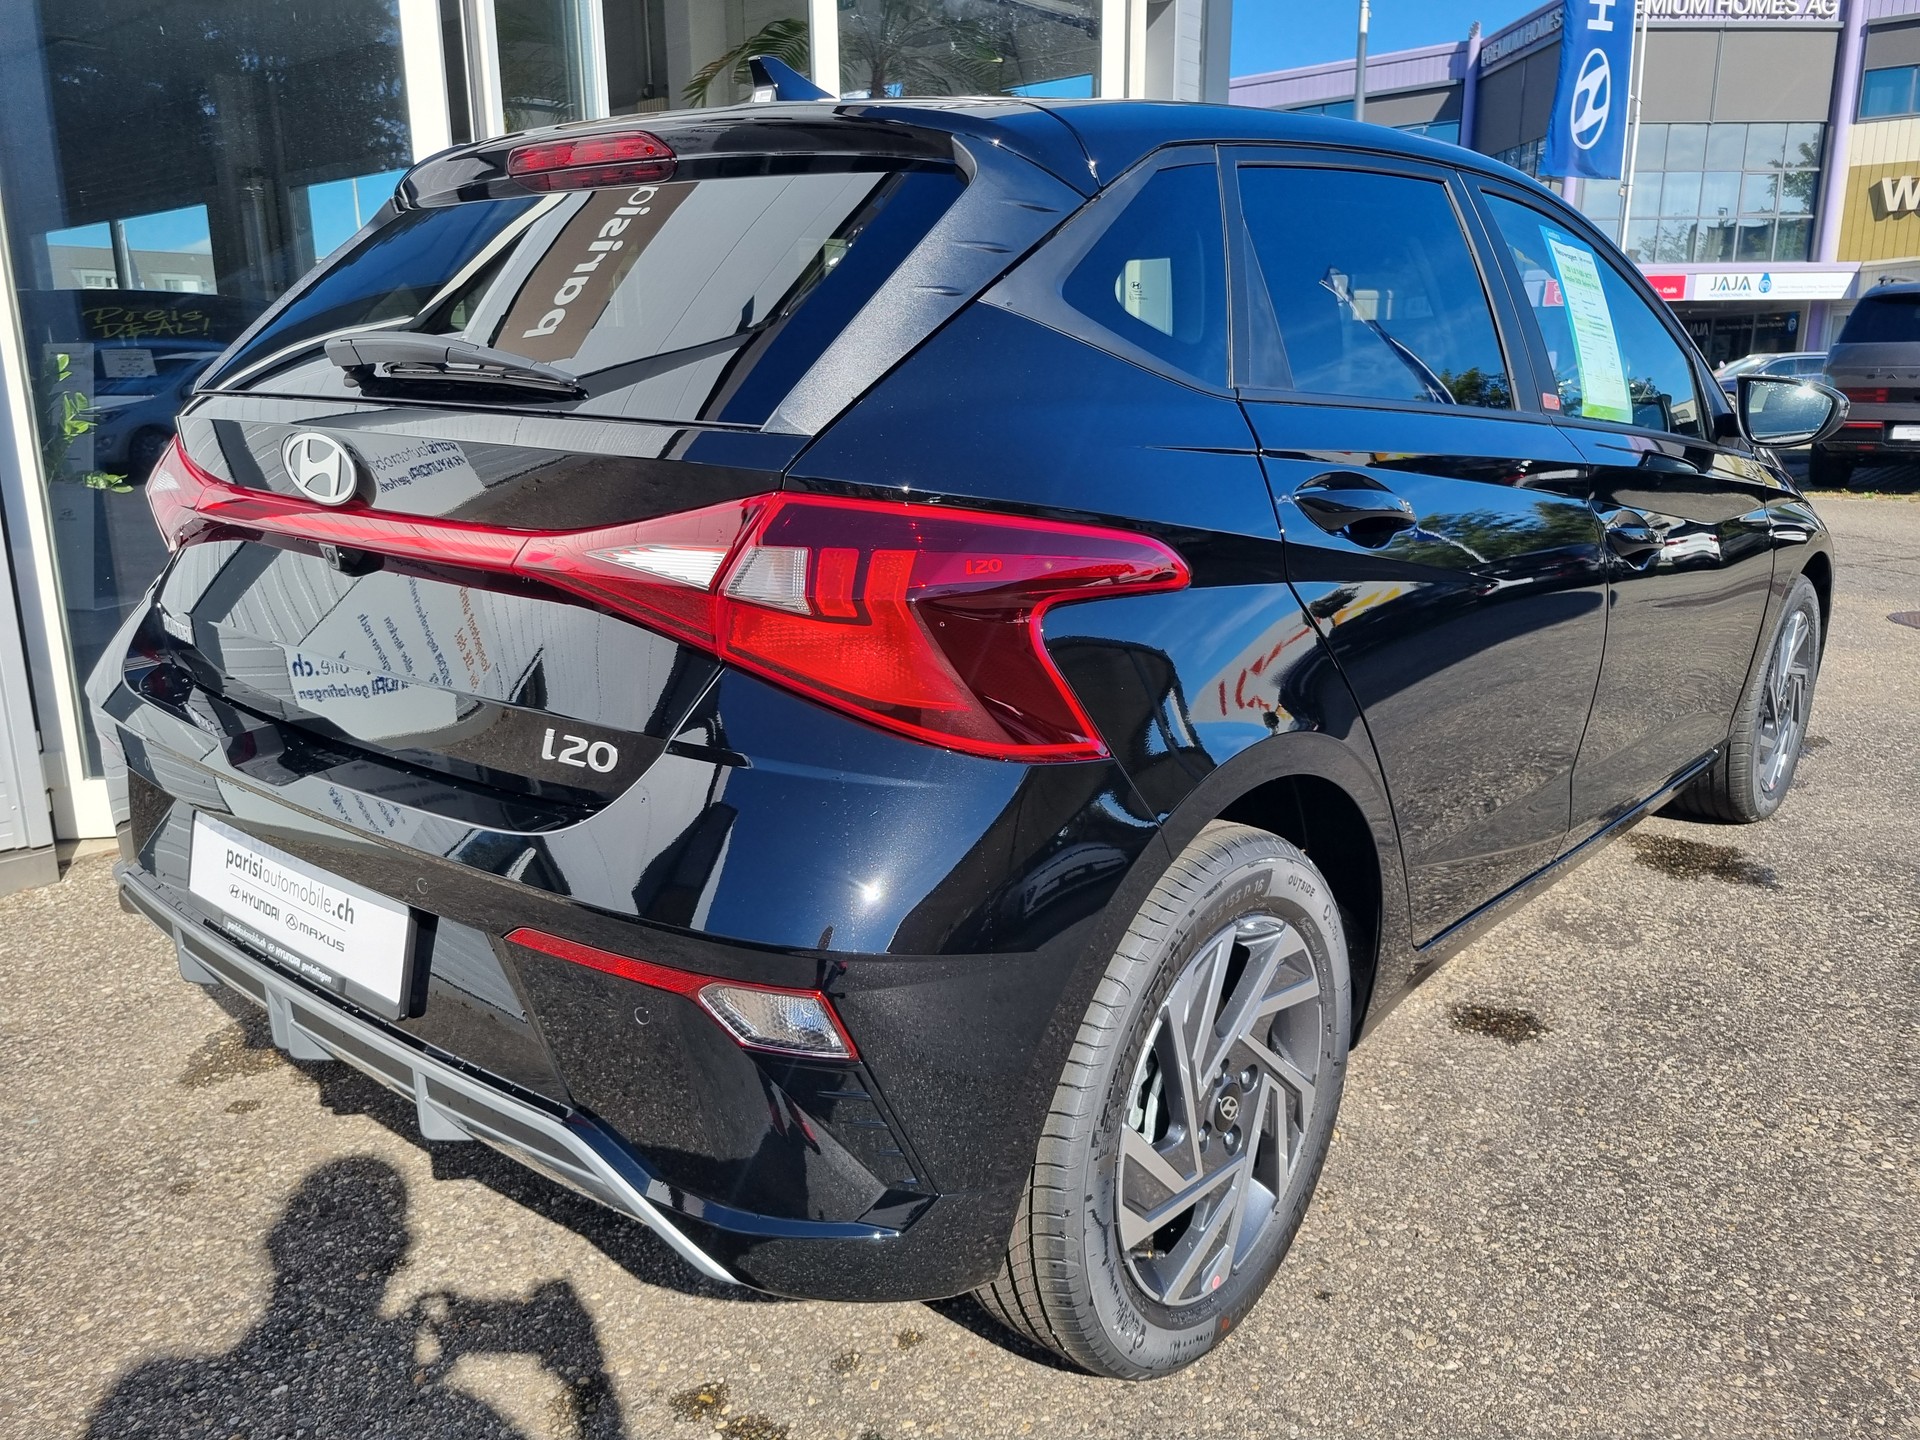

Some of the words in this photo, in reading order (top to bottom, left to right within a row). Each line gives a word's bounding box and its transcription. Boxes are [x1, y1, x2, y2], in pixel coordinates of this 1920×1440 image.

[1719, 0, 1798, 14] HOMES
[1804, 0, 1838, 14] AG
[1710, 275, 1751, 291] JAJA
[226, 848, 355, 925] parisiautomobile.ch
[1287, 875, 1316, 898] OUTSIDE
[241, 890, 280, 921] HYUNDAI
[299, 922, 345, 952] MAXUS
[276, 946, 300, 967] HYUNDAI
